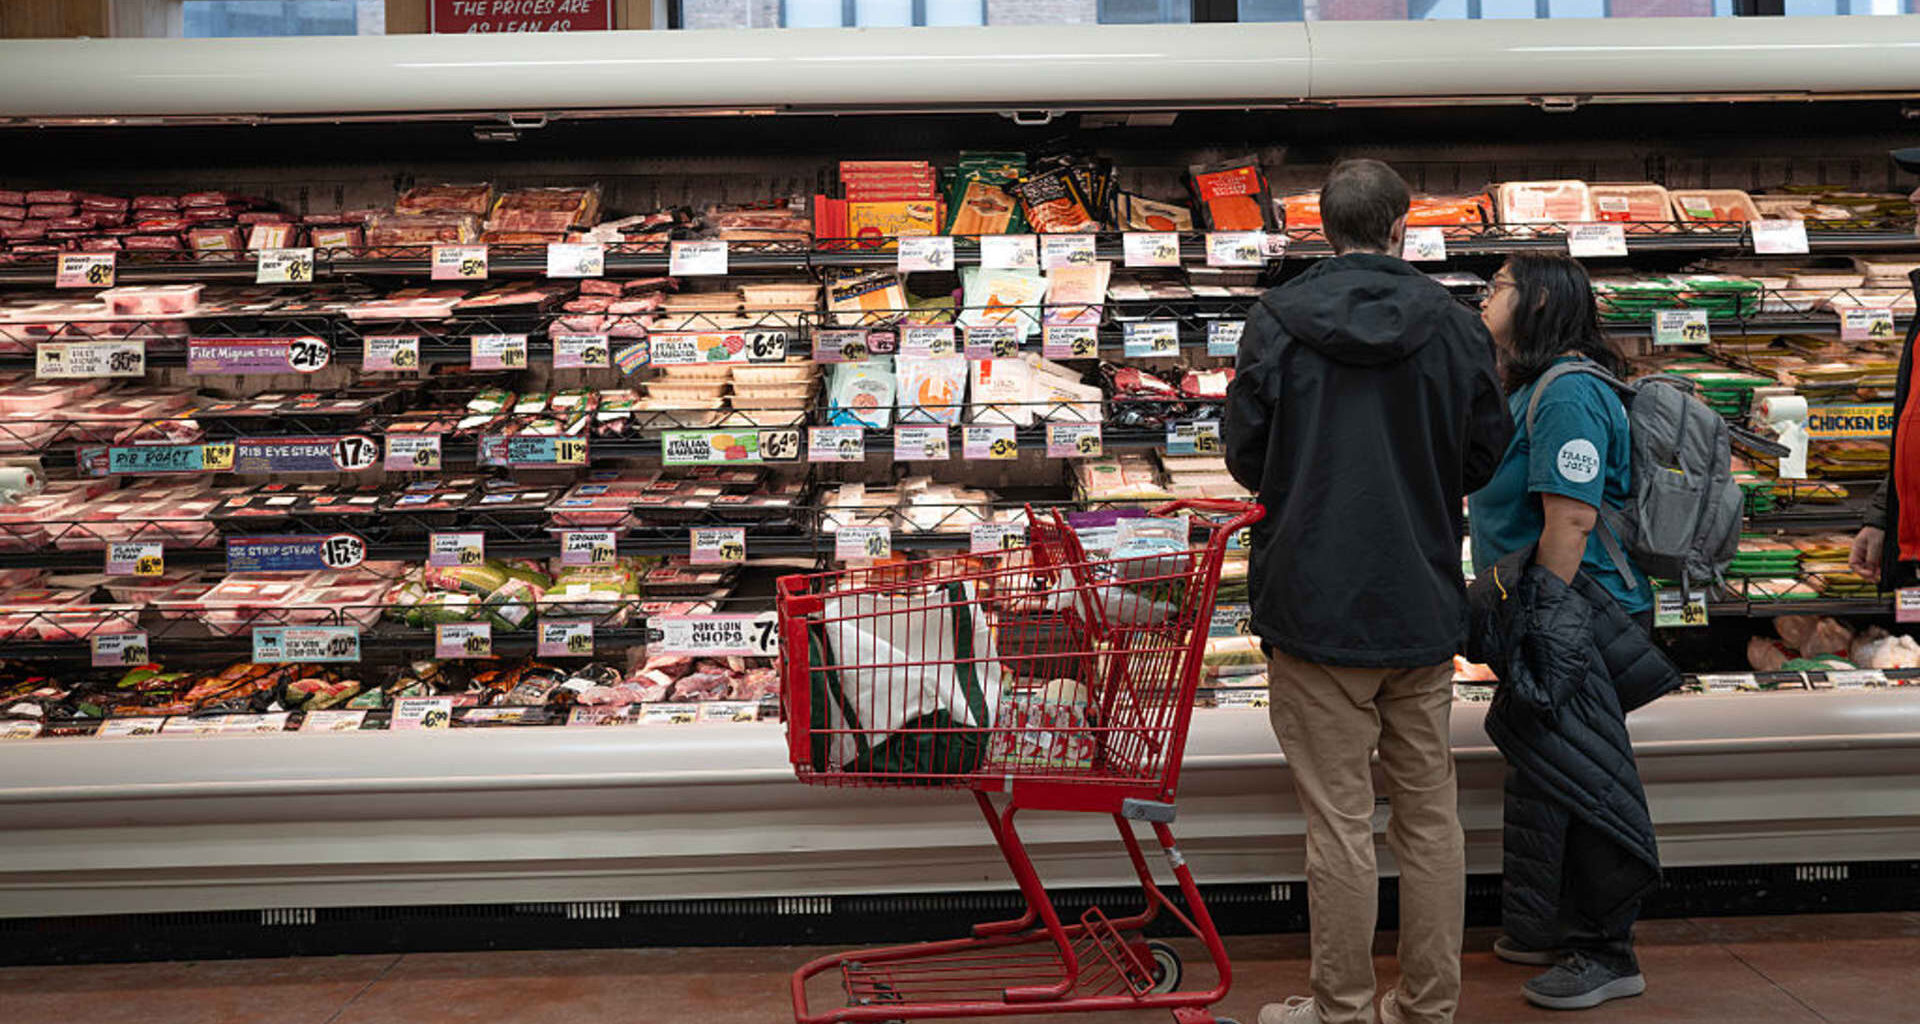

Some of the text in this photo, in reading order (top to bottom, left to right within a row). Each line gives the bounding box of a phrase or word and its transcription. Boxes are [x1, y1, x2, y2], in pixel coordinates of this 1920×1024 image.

[452, 0, 592, 17] THE PRICES ARE
[466, 18, 571, 34] AS LEAN AS
[655, 342, 696, 350] ITALIAN
[190, 346, 216, 360] Filet
[217, 346, 256, 363] Mignon
[1808, 414, 1874, 432] CHICKEN
[670, 439, 708, 447] ITALIAN
[146, 450, 192, 463] ROAST
[240, 445, 330, 457] RIB EYE STEAK
[1564, 459, 1592, 474] JOE'S
[568, 534, 609, 542] GROUND
[248, 545, 281, 556] STRIP
[281, 544, 317, 556] STEAK
[568, 542, 594, 551] LAMB
[692, 621, 742, 632] PORK LOIN
[691, 631, 744, 643] CHOPS
